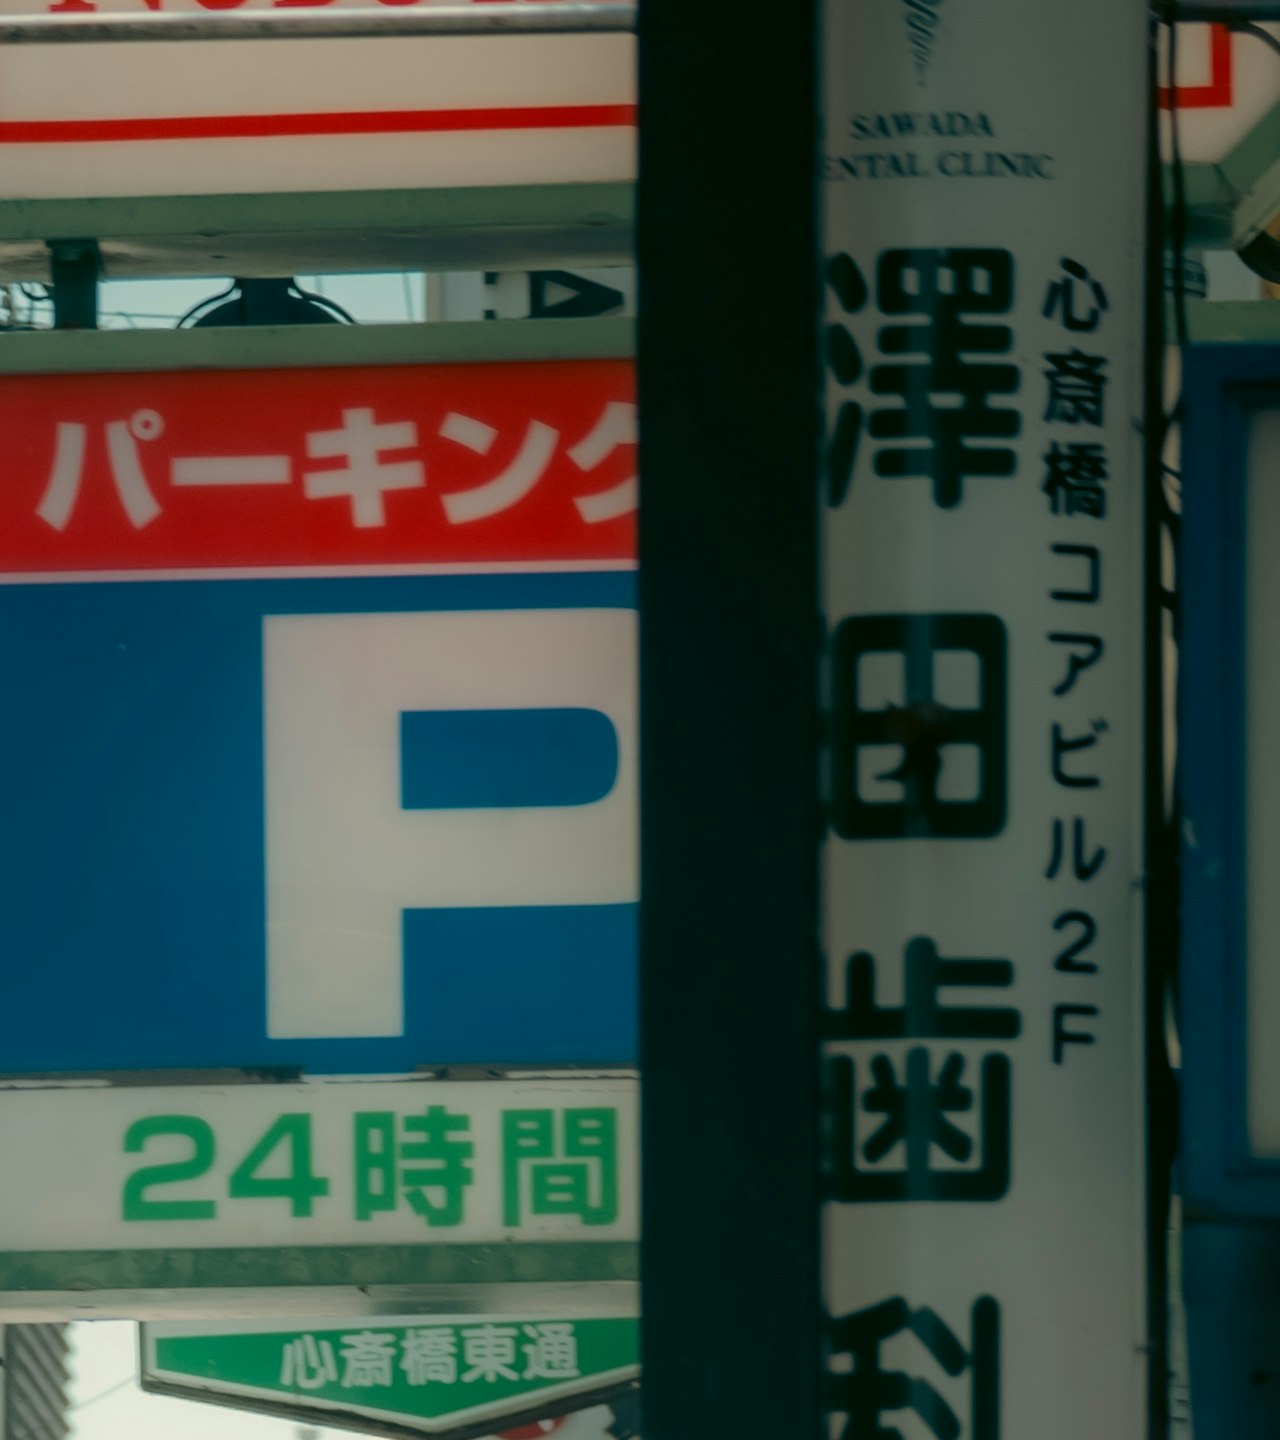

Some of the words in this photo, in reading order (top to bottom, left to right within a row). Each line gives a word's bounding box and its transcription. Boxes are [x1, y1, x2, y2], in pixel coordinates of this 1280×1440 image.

[850, 111, 997, 141] SAWADA
[937, 150, 1056, 180] CLINIC
[262, 608, 638, 1038] P
[119, 1103, 621, 1230] 24時間
[279, 1321, 582, 1391] 心斎橋東通
